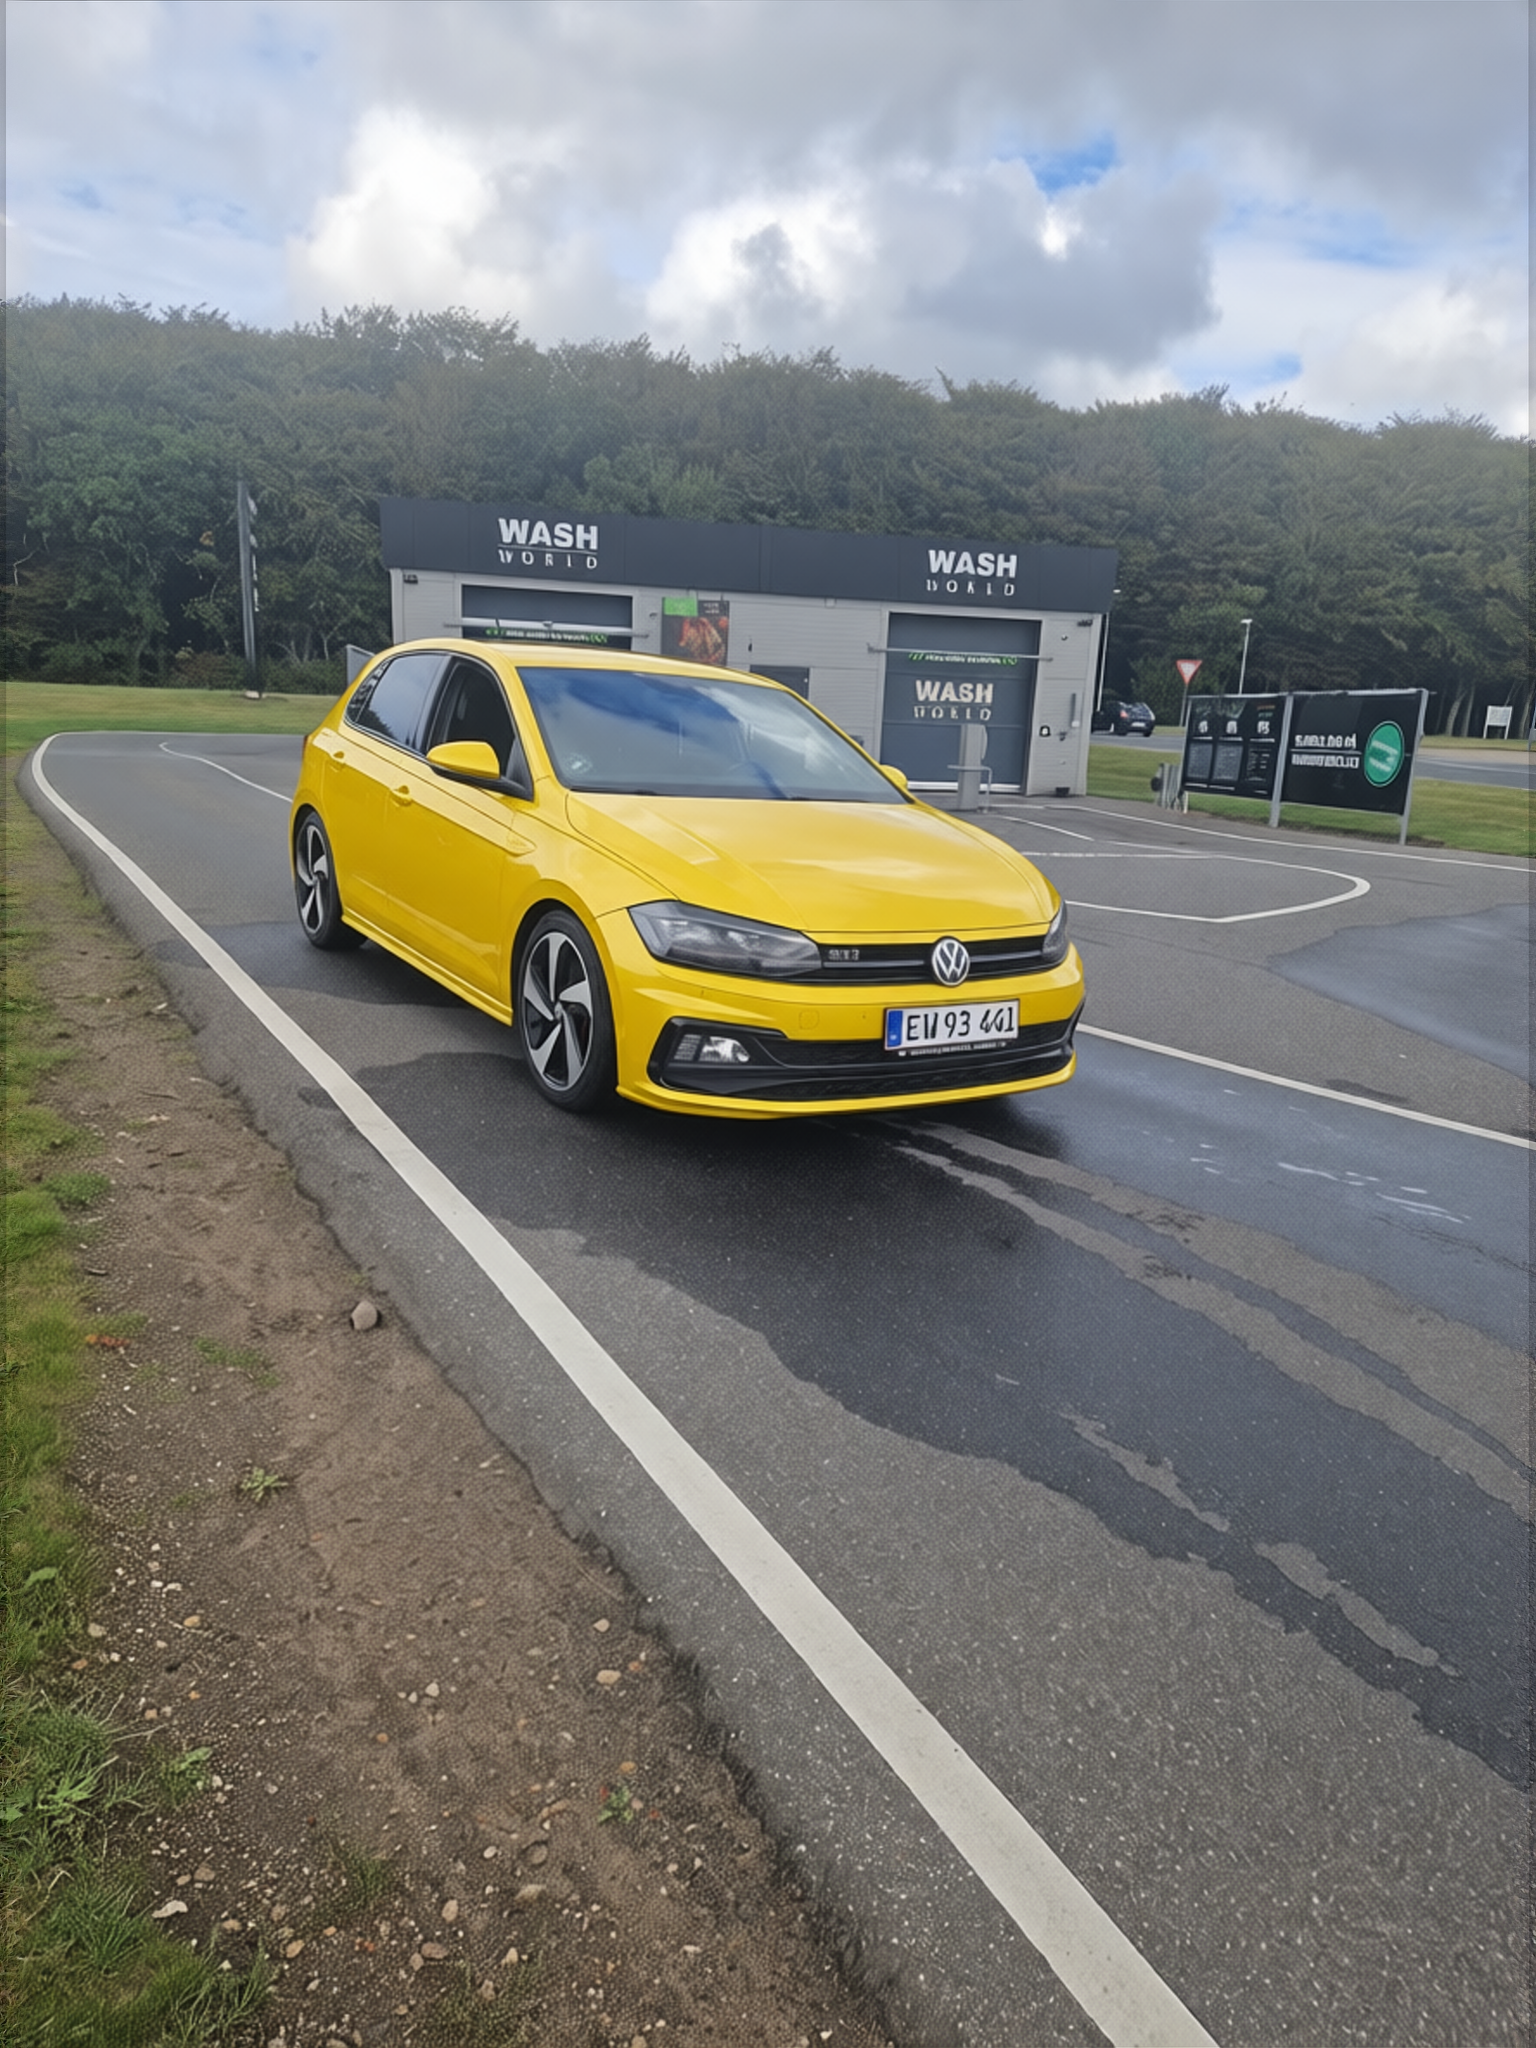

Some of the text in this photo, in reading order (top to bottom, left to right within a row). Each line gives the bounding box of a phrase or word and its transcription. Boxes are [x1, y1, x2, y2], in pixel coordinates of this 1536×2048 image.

[497, 517, 599, 550] WASH
[928, 549, 1018, 578] WASH
[915, 679, 994, 704] WASH
